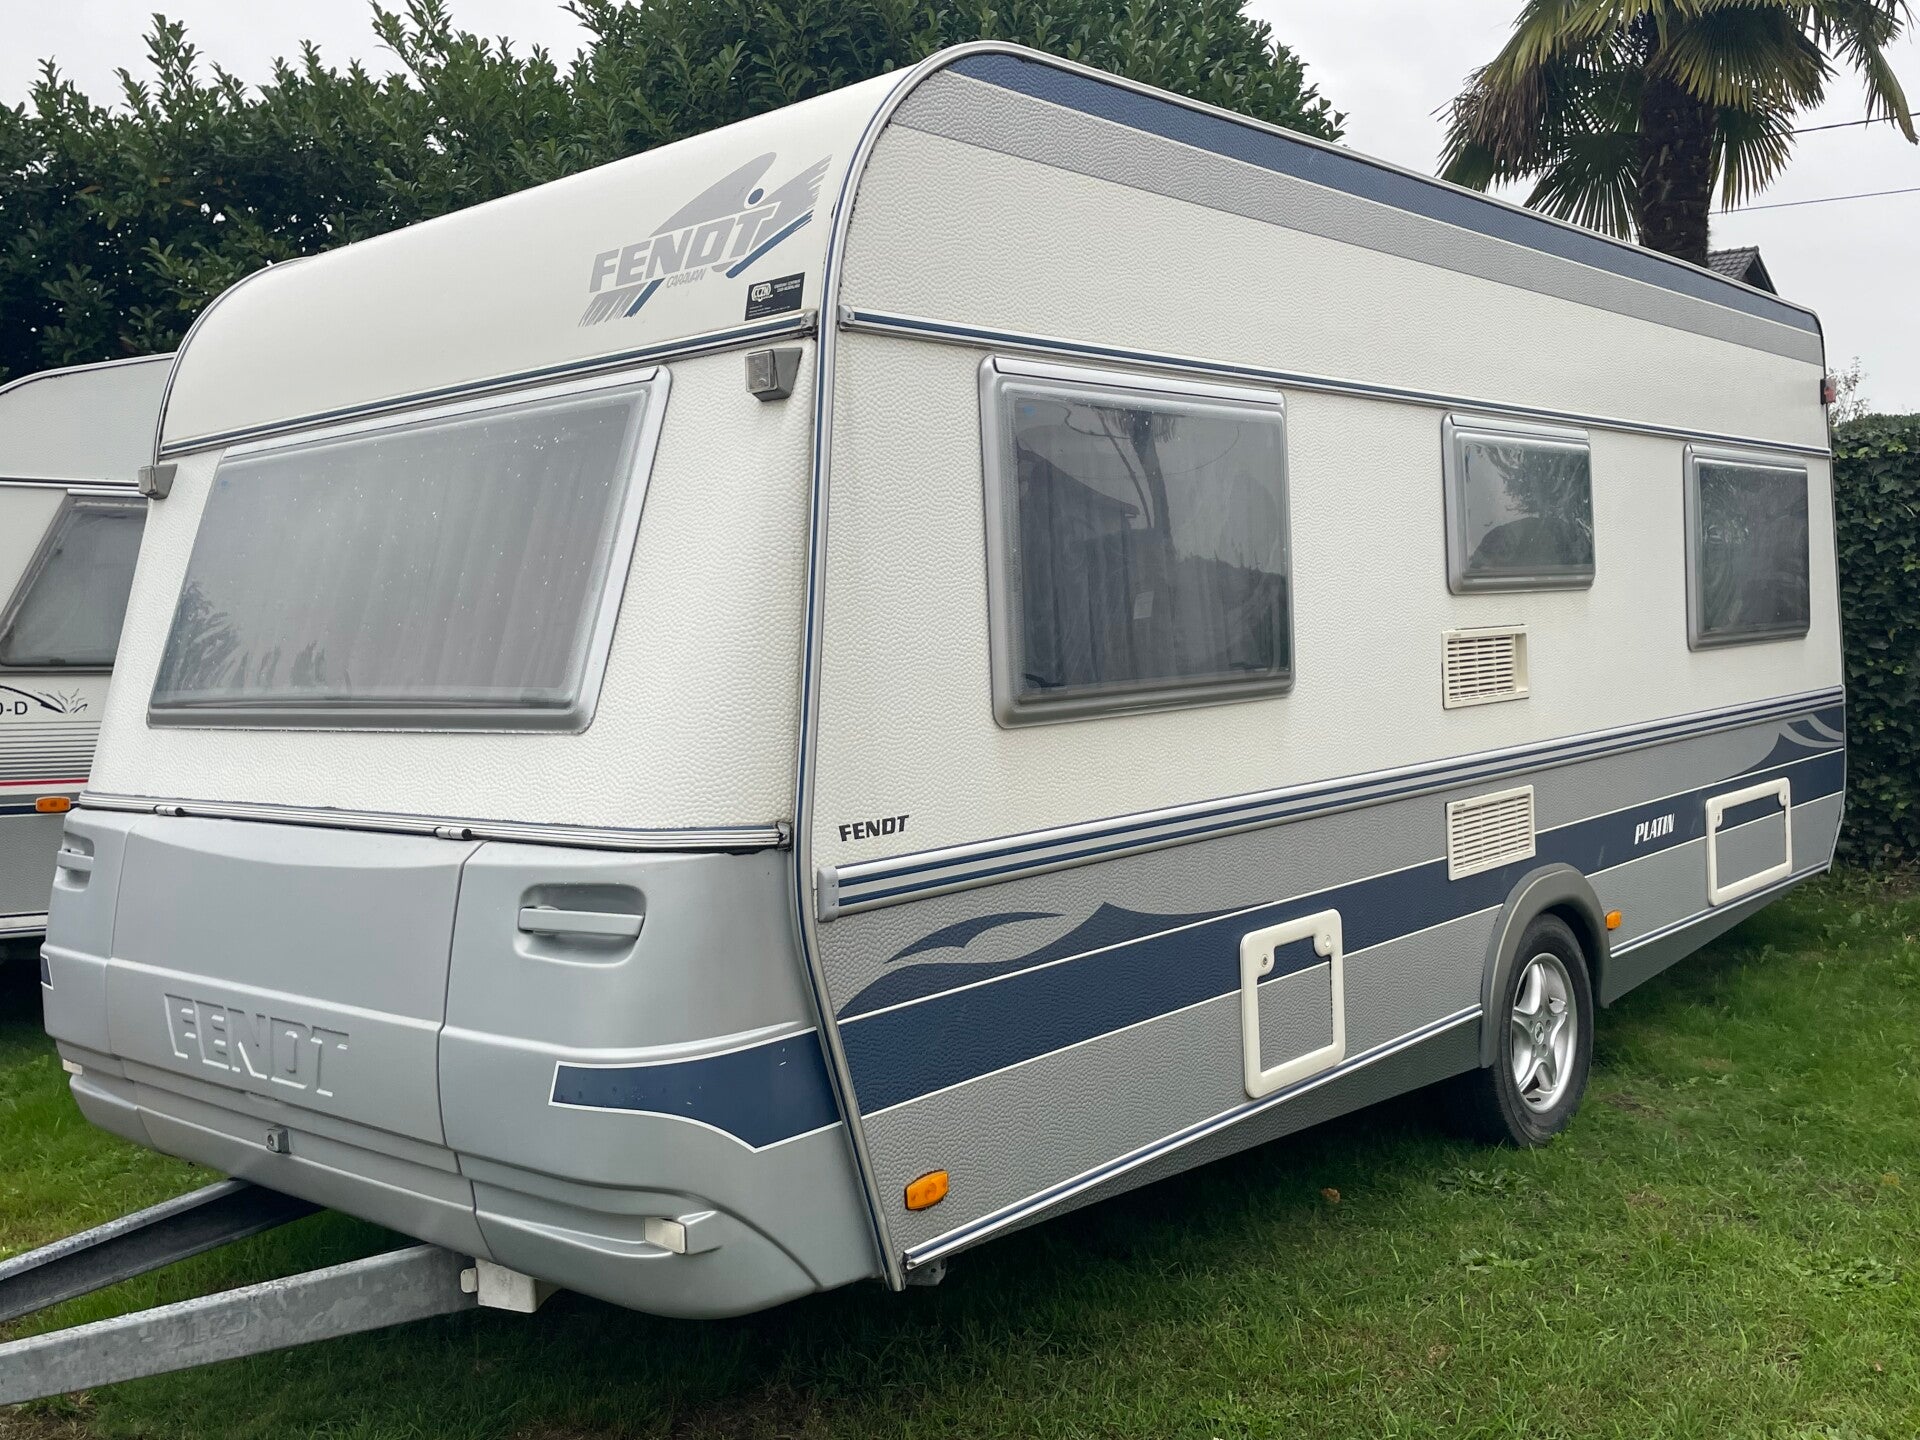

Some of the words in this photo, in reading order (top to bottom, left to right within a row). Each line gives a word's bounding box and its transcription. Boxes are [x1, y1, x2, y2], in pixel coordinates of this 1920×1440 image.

[589, 205, 778, 293] FENDT
[0, 701, 28, 716] -D
[838, 814, 909, 842] FENDT
[1634, 813, 1675, 845] PLATIN
[164, 993, 349, 1097] FENDT
